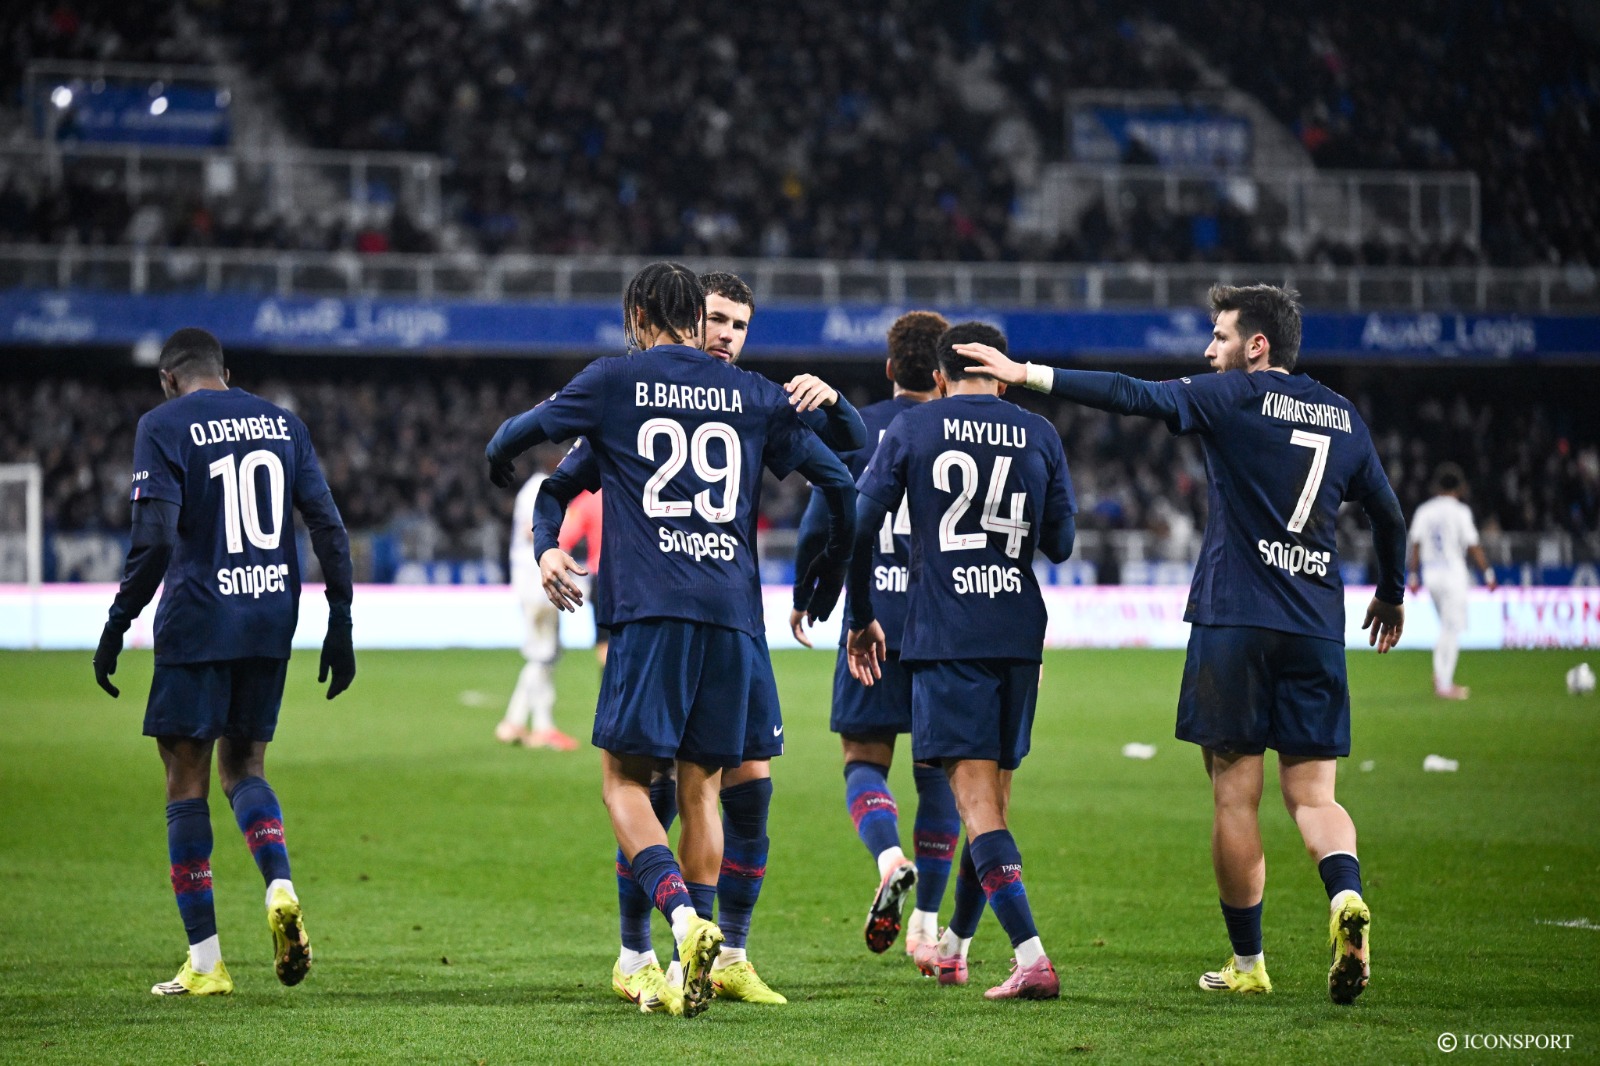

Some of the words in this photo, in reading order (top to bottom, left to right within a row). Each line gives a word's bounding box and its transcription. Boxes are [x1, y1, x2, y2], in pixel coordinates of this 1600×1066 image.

[635, 382, 743, 413] B.BARCOLA
[1261, 391, 1352, 434] KVARATSKHELIA
[943, 418, 1027, 448] MAYULU
[637, 417, 742, 523] 29
[1286, 429, 1331, 533] 7
[209, 449, 285, 554] 10
[932, 450, 1031, 559] 24
[658, 526, 738, 561] snipes
[217, 564, 289, 598] snipes
[874, 565, 909, 592] sni
